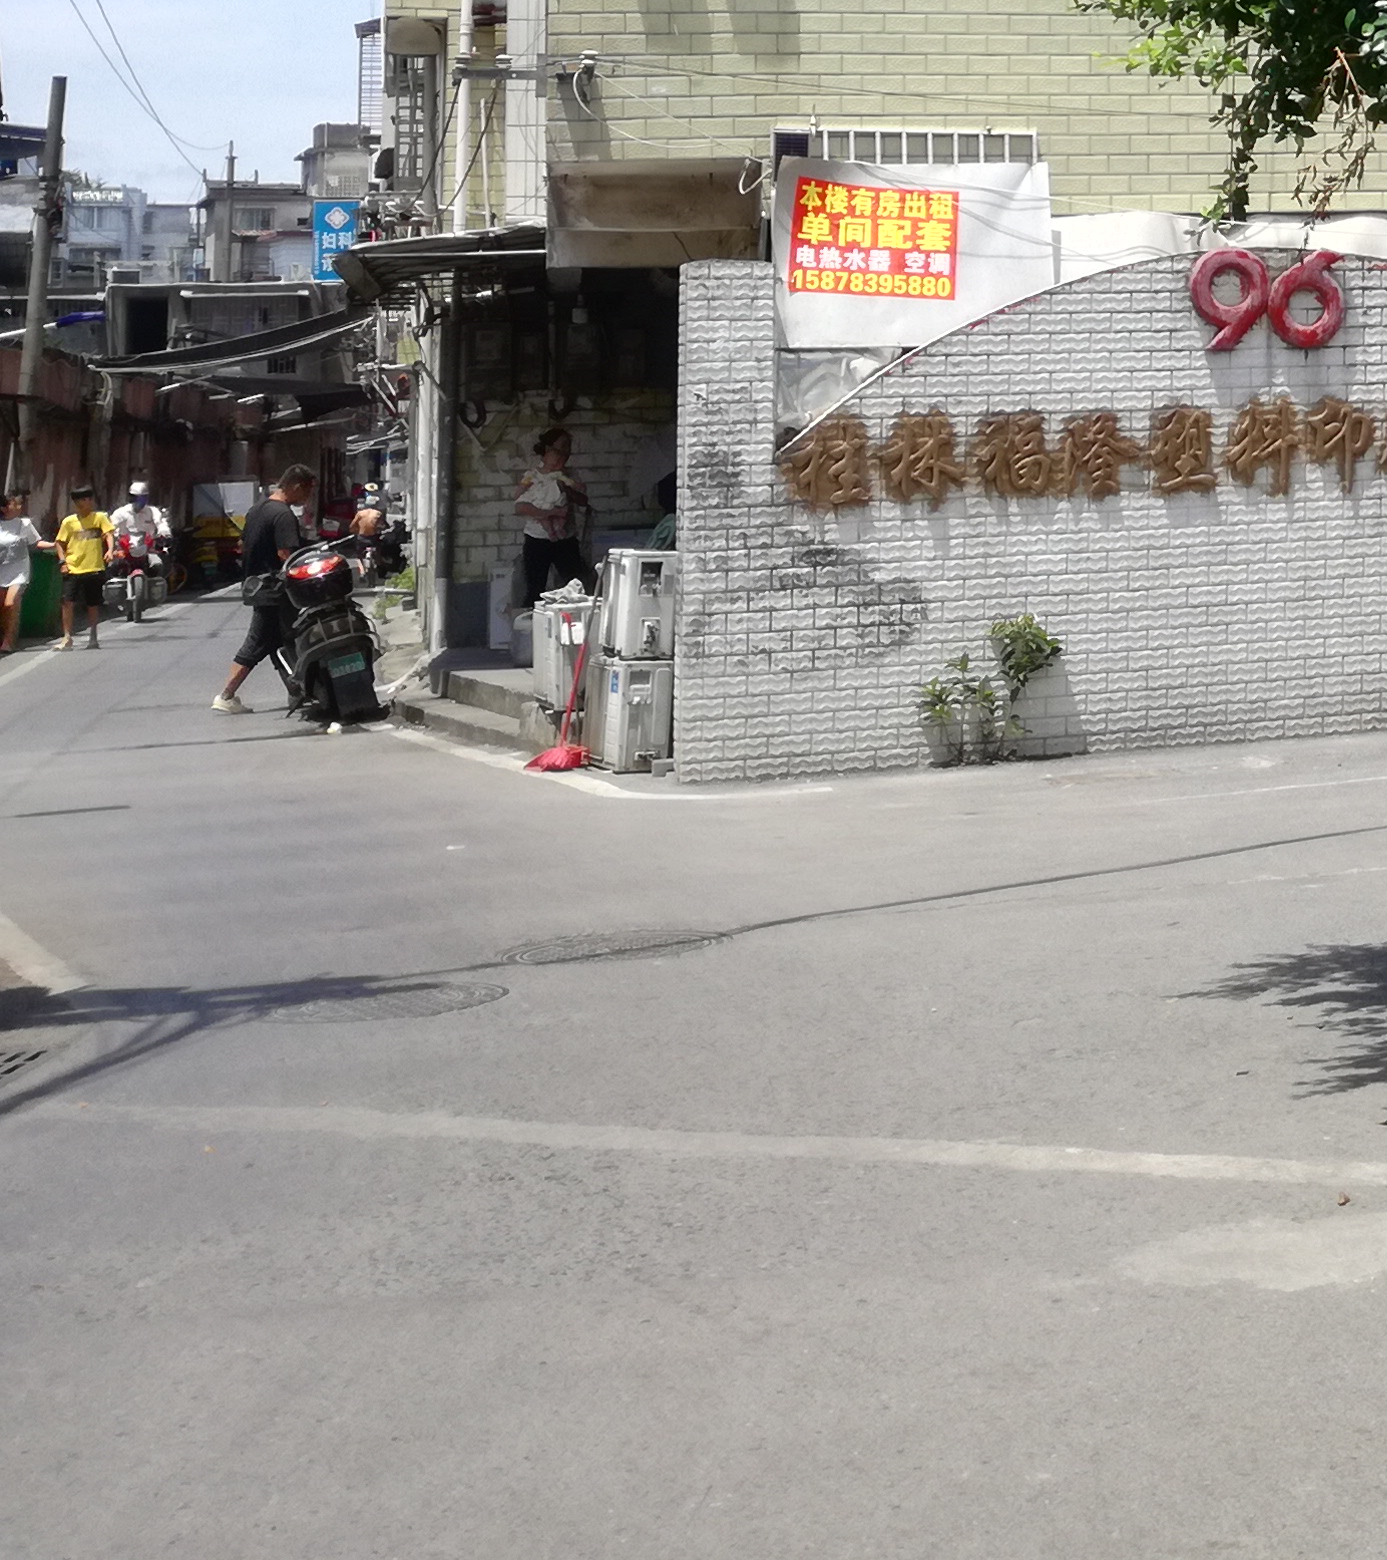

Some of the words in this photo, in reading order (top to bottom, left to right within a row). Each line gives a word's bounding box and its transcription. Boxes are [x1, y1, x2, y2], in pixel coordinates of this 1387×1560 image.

[799, 180, 954, 220] 本楼有房出租
[797, 211, 952, 252] 单间配套
[795, 244, 891, 272] 电热水器
[903, 251, 951, 275] 空调
[791, 268, 951, 297] 15878395880
[1190, 246, 1343, 352] 96
